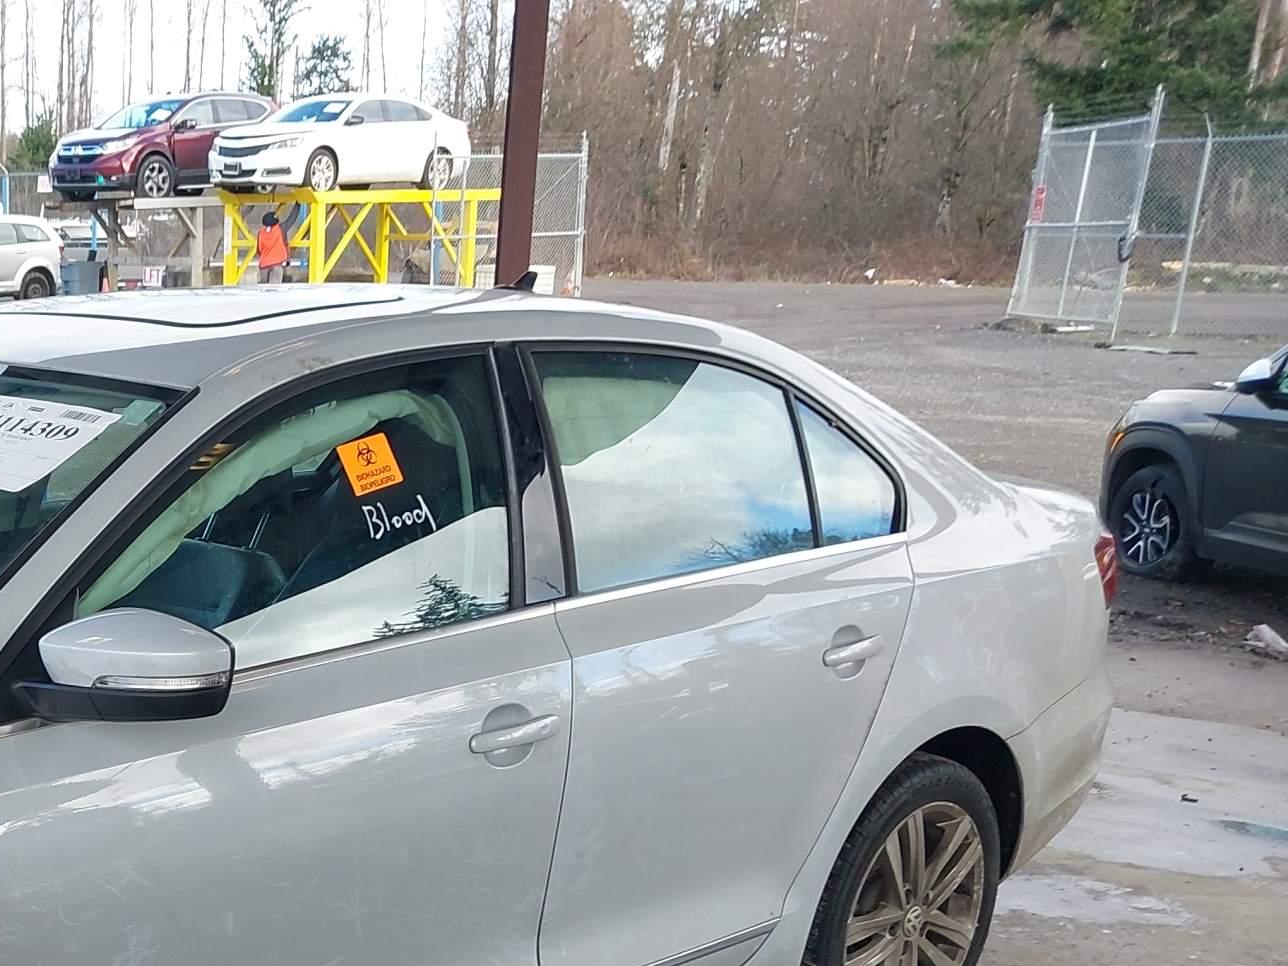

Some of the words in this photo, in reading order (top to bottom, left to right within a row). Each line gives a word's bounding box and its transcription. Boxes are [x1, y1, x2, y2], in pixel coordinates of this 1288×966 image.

[356, 464, 392, 483] BIOHAZARD
[359, 474, 396, 492] BIOPELIGRO
[361, 494, 437, 540] Blood
